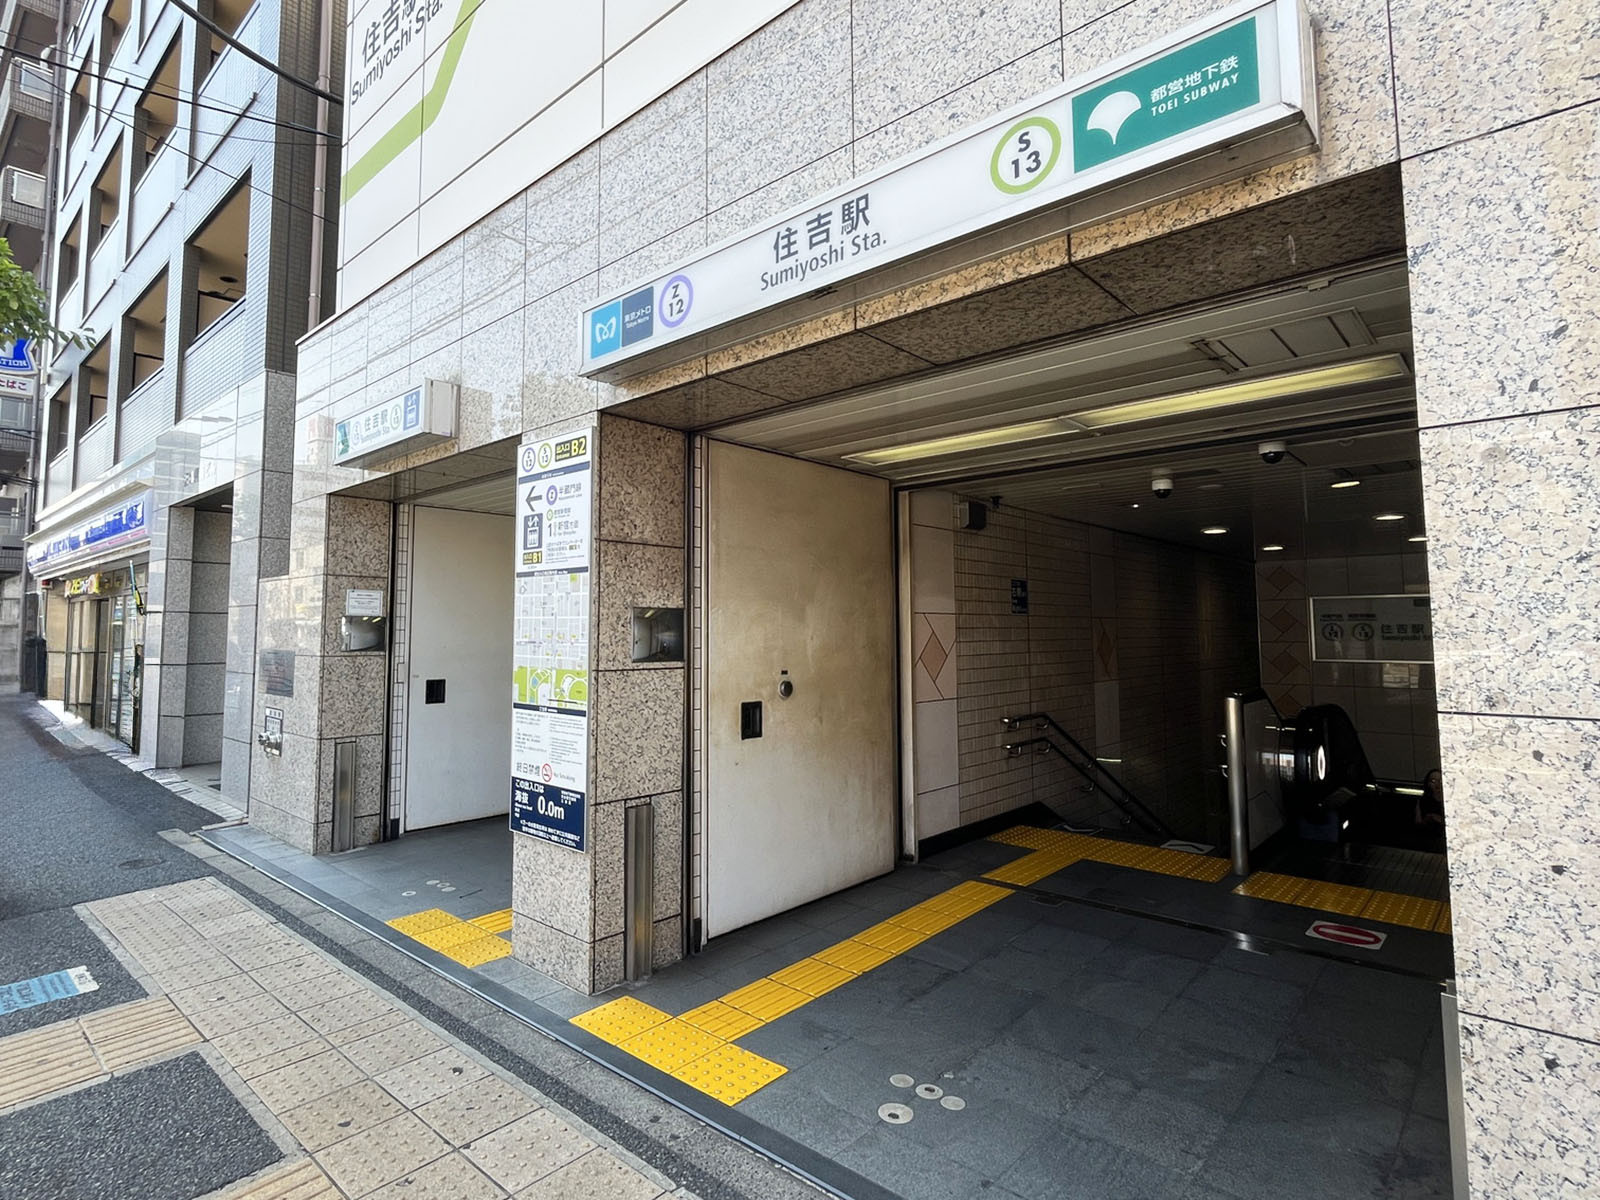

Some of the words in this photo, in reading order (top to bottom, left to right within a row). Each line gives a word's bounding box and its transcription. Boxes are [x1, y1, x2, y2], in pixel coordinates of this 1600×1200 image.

[351, 20, 412, 106] Sumiyoshi
[414, 0, 443, 35] Sta.
[1150, 55, 1239, 103] 都営地下鉄
[1151, 101, 1179, 117] TOEI
[1183, 72, 1240, 105] SUBWAY
[1018, 131, 1032, 153] S
[1011, 150, 1042, 180] 13
[773, 193, 870, 264] 住吉駅
[760, 240, 845, 292] Sumiyoshi
[851, 232, 887, 257] Sta.
[671, 283, 681, 301] Z
[668, 298, 685, 318] 12
[571, 437, 586, 457] B2
[537, 794, 565, 820] 0.0m
